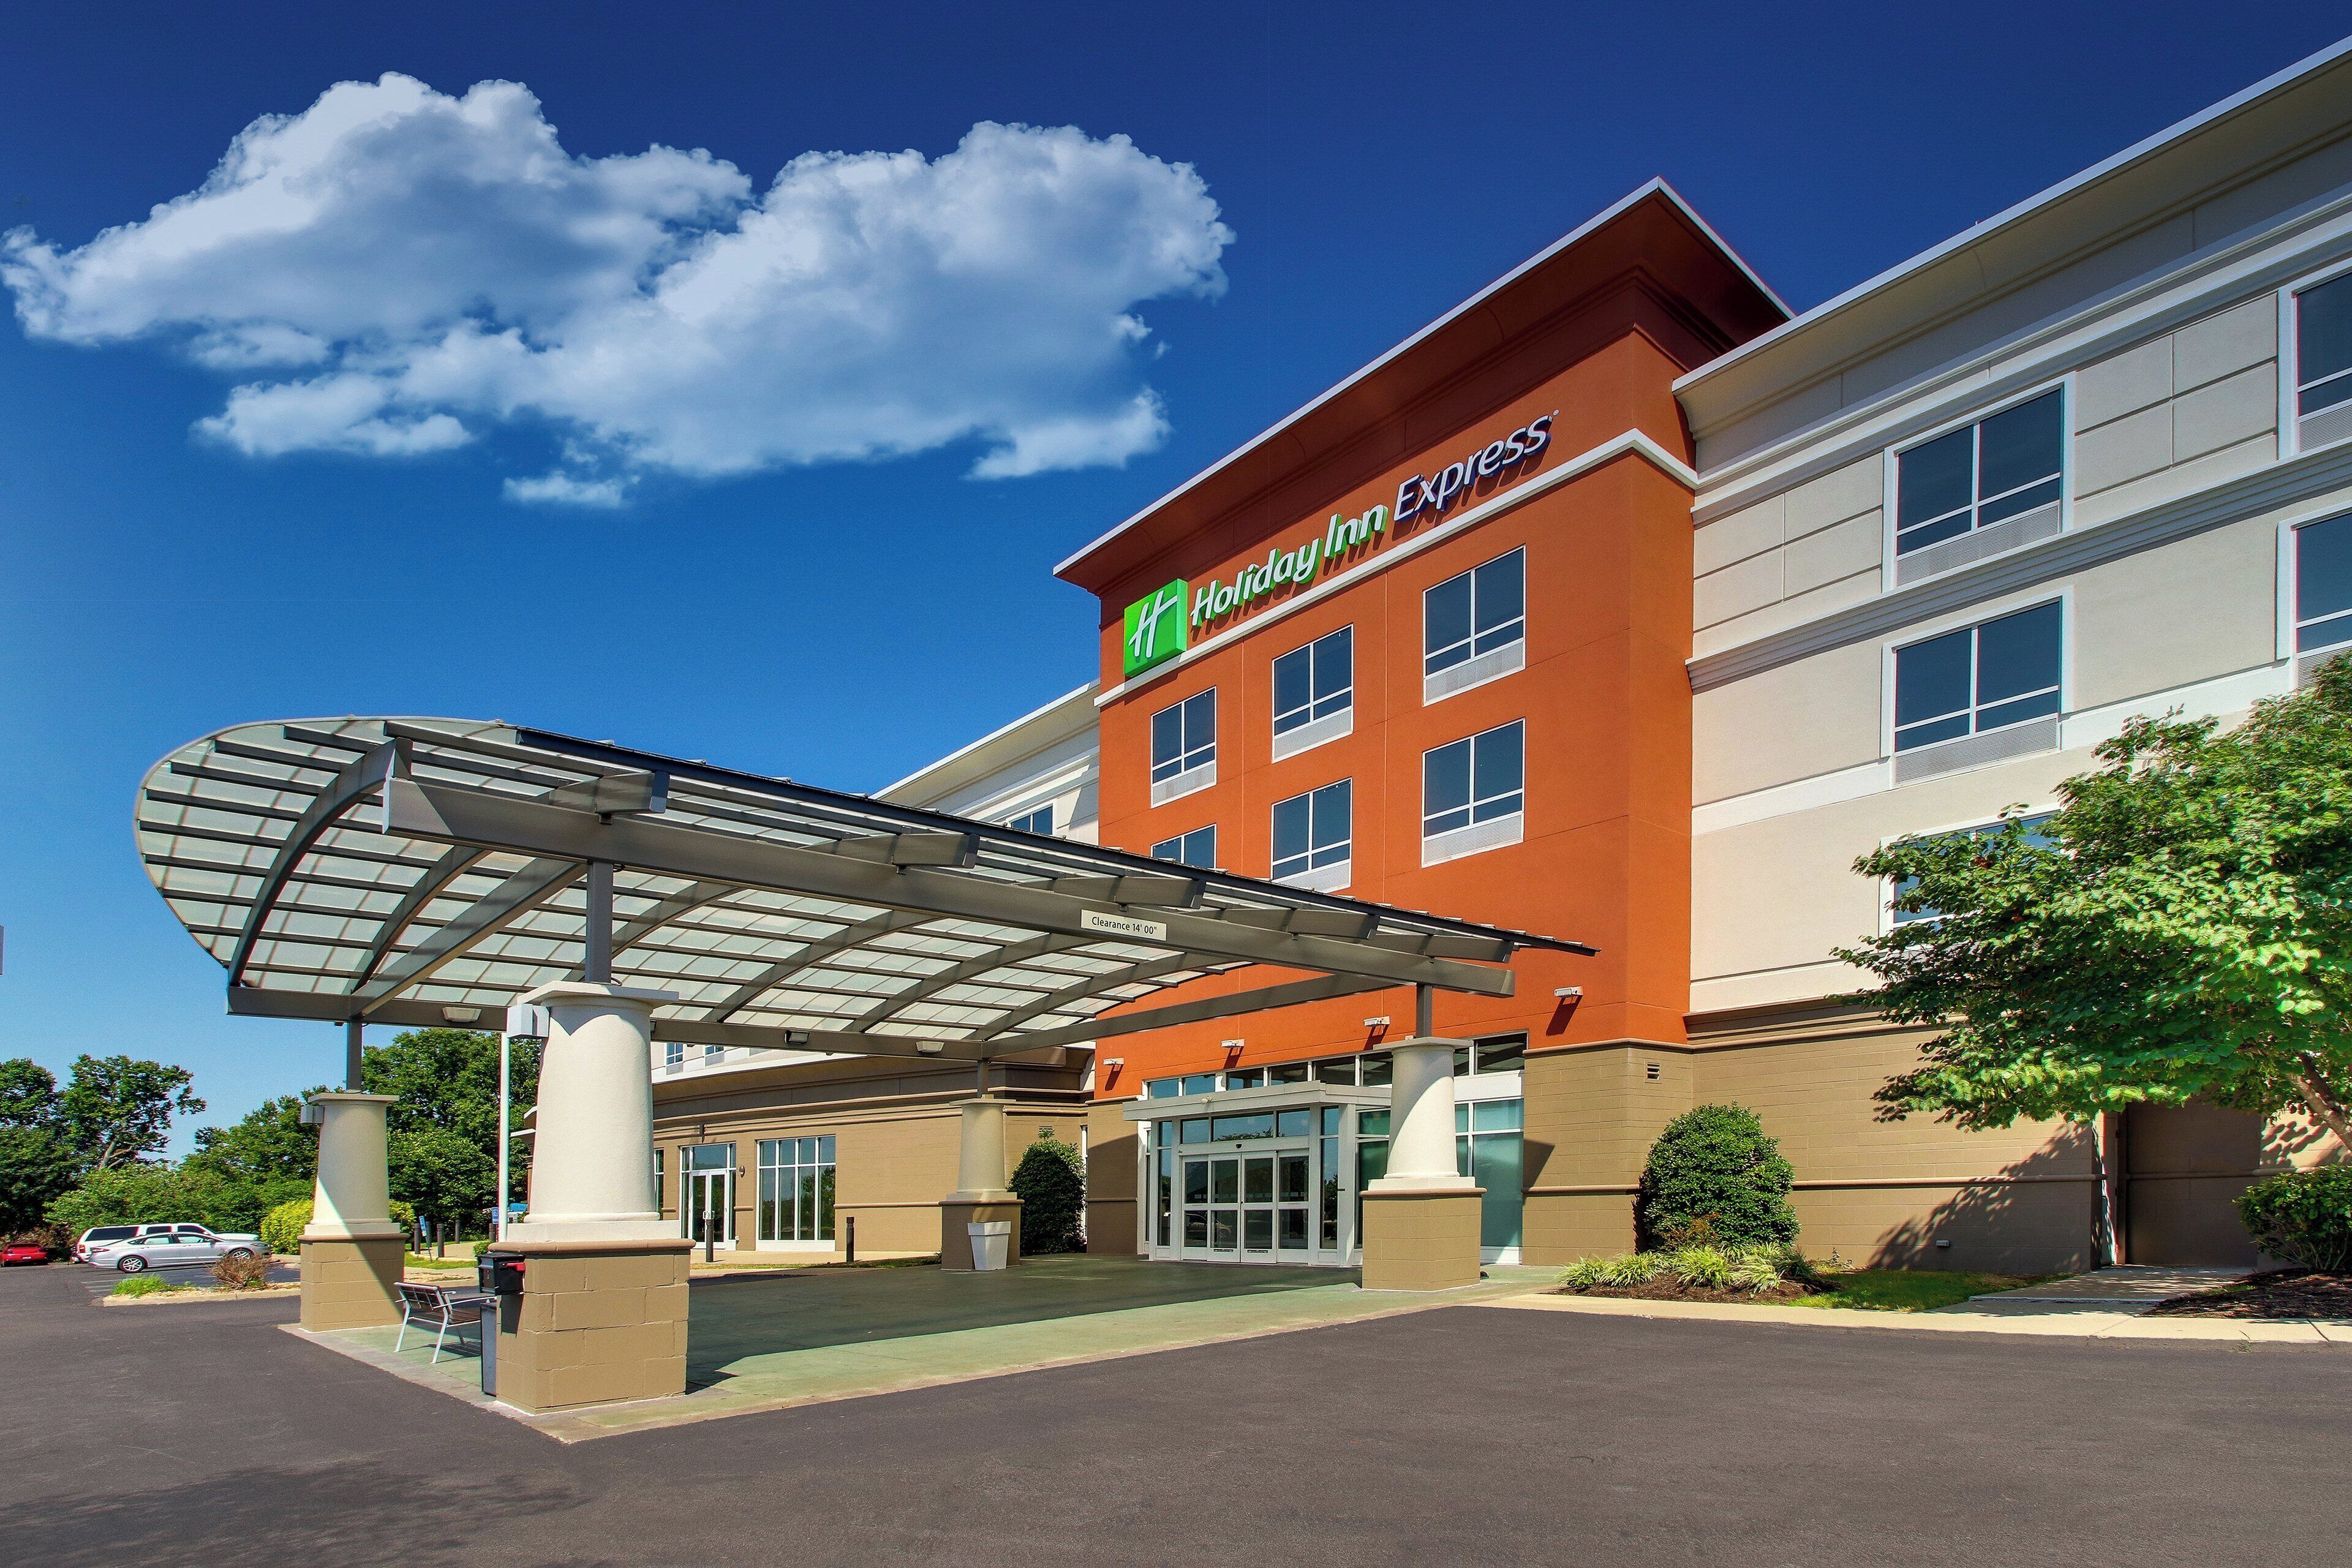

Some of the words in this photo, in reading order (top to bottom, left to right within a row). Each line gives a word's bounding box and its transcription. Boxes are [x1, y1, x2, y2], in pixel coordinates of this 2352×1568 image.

[1189, 537, 1322, 626] Holiday
[1324, 504, 1387, 558] Inn
[1393, 415, 1551, 521] Express
[1091, 916, 1130, 931] Clearance
[1133, 923, 1142, 932] 14'
[1144, 925, 1157, 935] 00"
